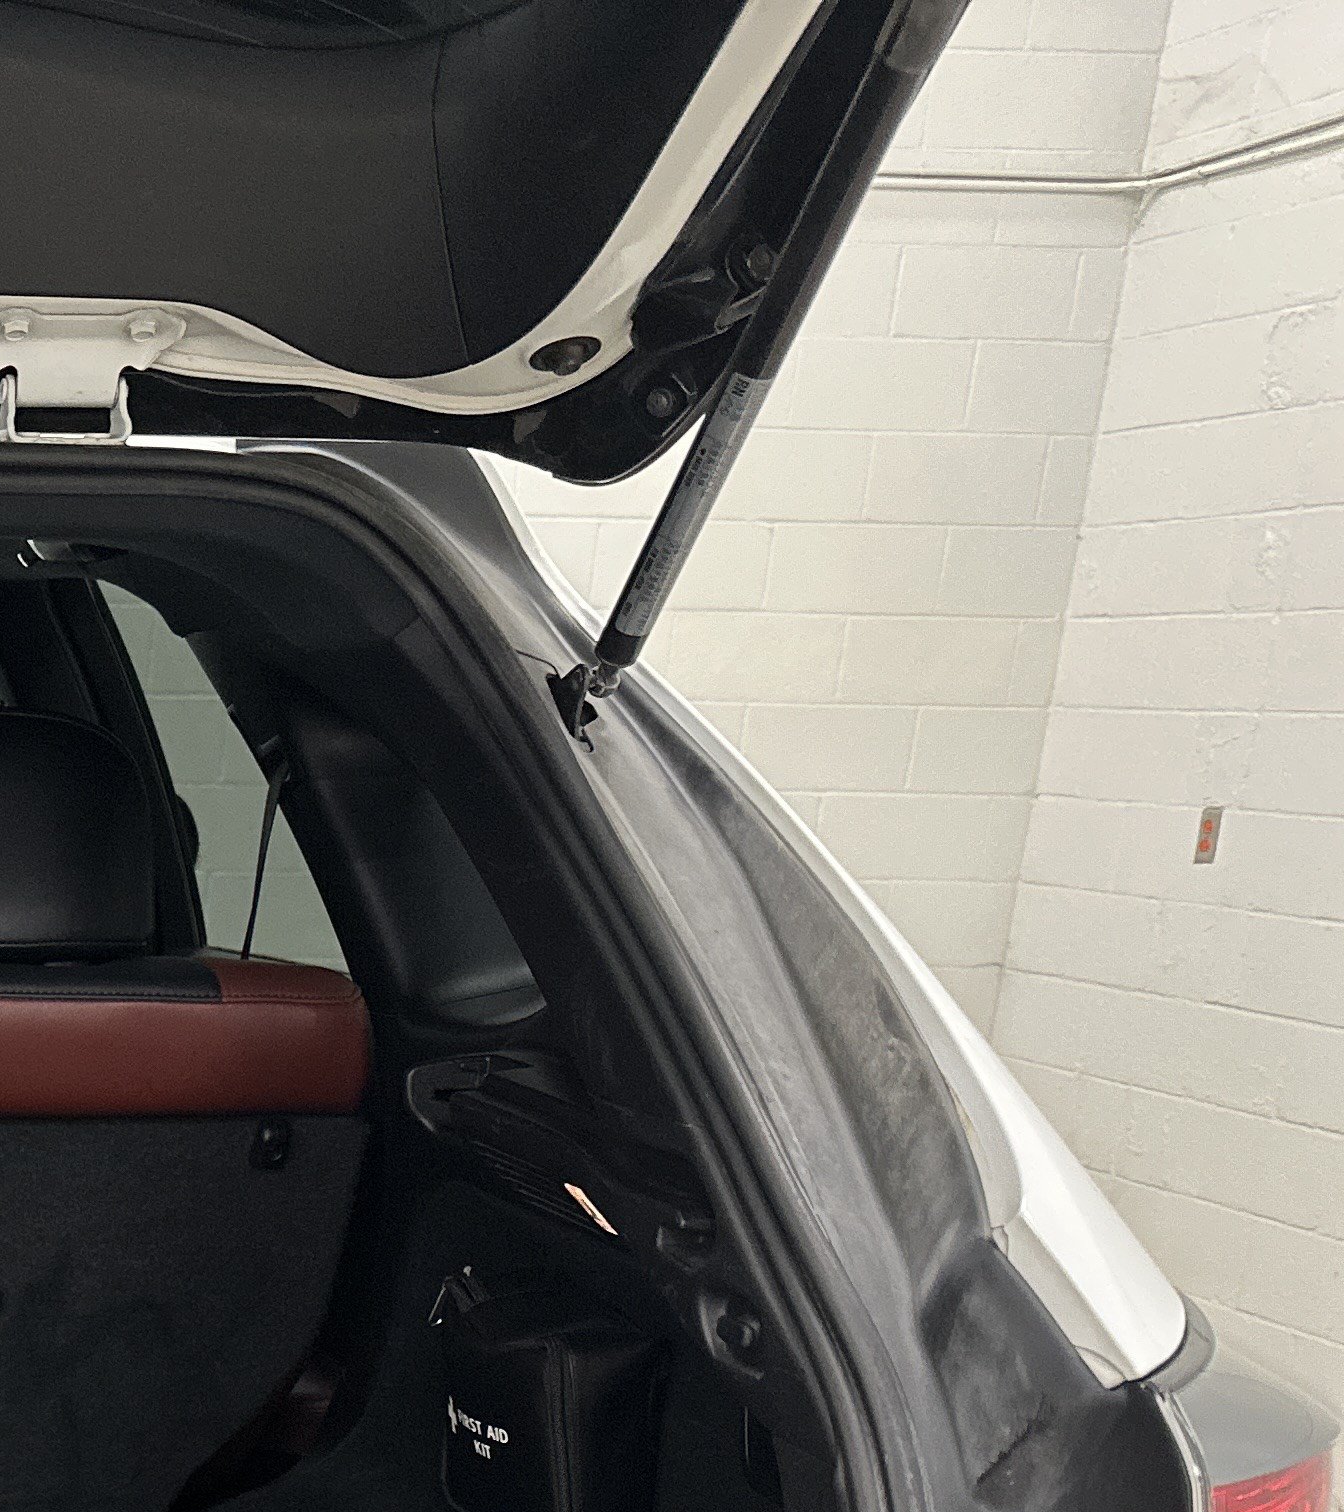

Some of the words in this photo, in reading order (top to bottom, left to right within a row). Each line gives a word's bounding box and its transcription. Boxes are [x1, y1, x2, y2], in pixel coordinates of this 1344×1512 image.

[456, 1408, 482, 1436] FIRST
[486, 1425, 509, 1444] AID
[473, 1439, 491, 1460] KIT
